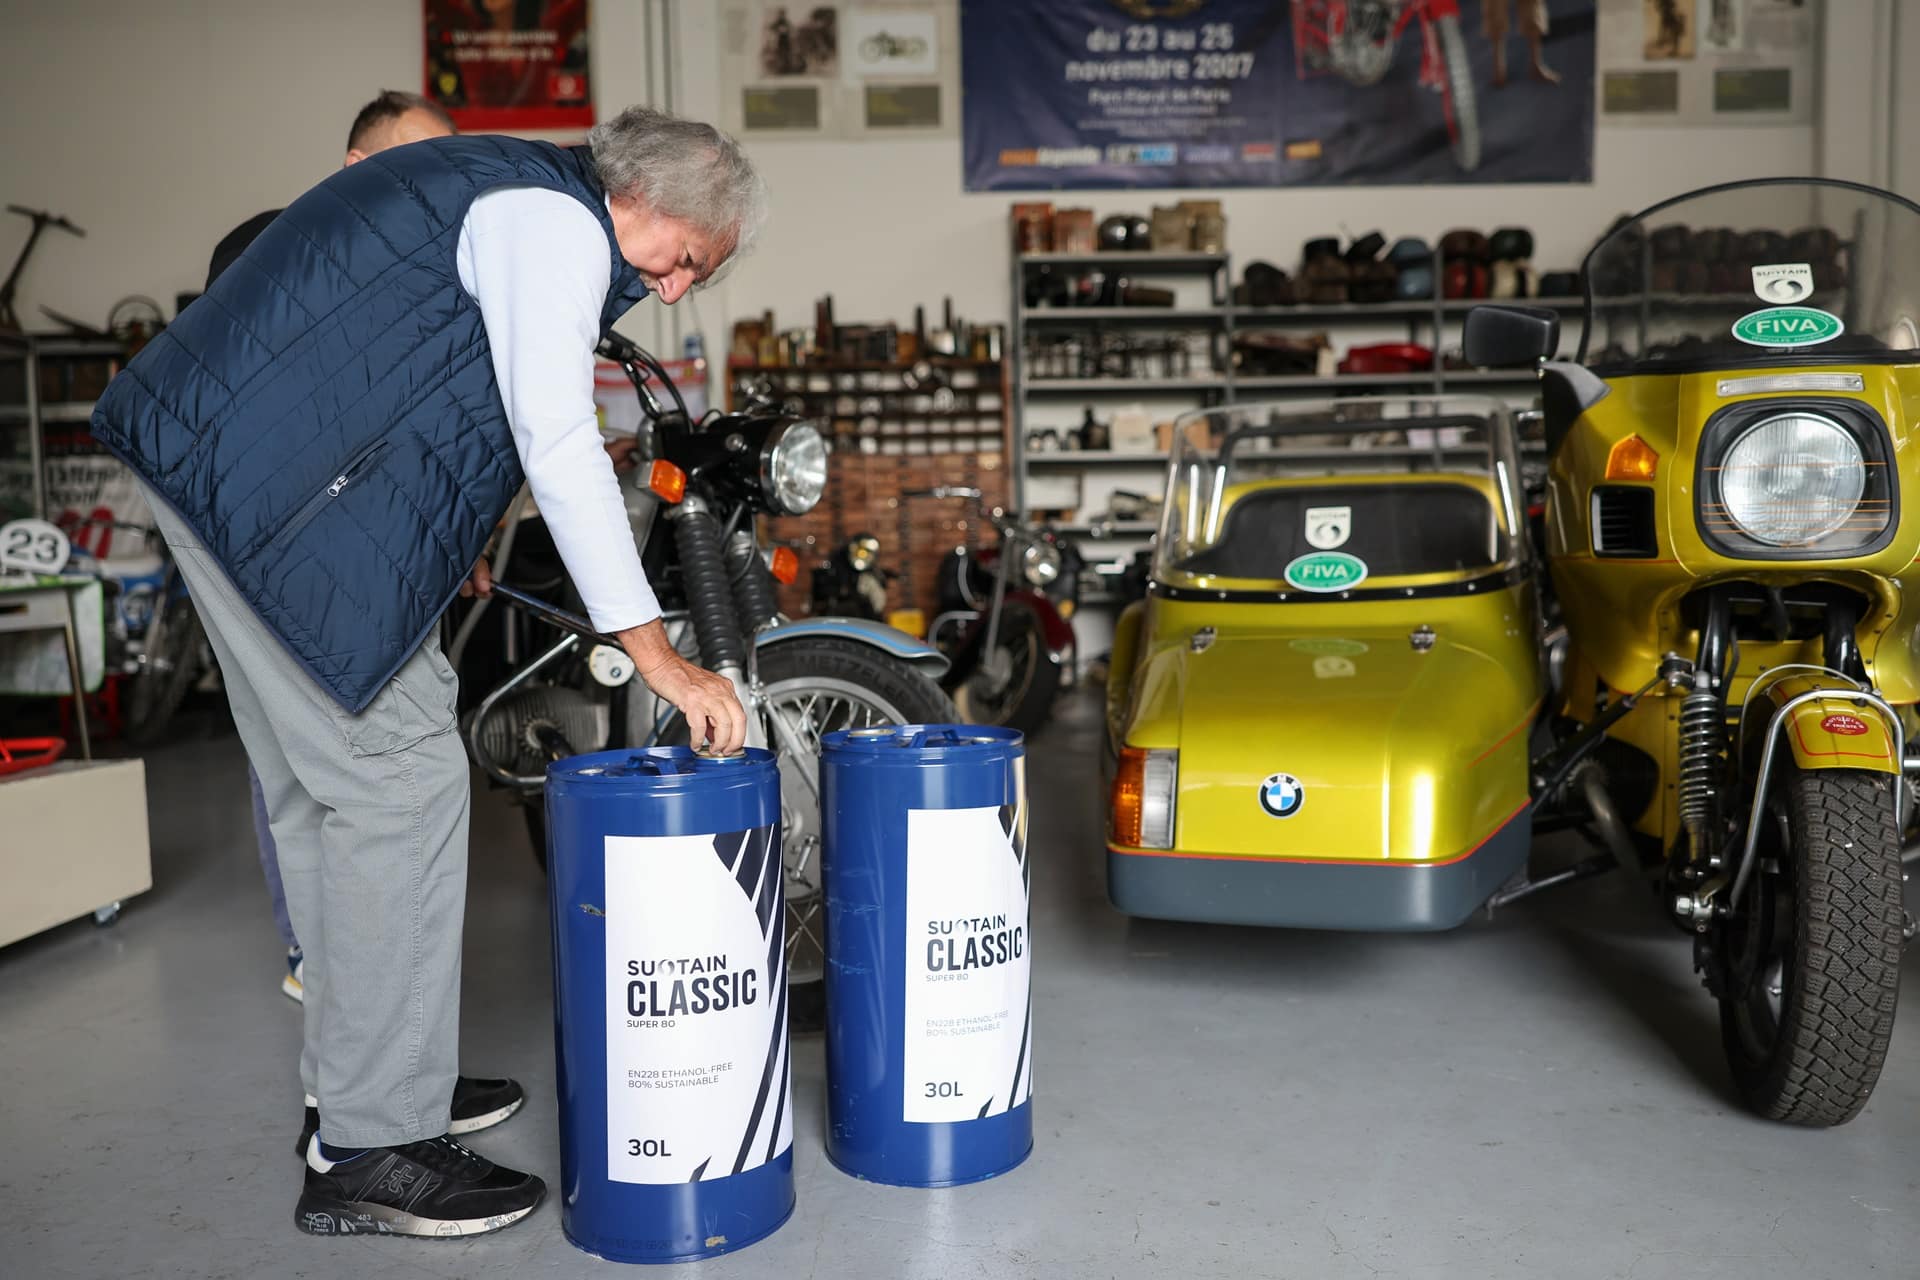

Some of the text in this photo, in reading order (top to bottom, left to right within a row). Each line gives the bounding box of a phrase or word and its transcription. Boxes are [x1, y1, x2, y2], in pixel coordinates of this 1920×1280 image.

[1087, 23, 1233, 52] du 23 au 25
[1065, 52, 1254, 81] novembre 2007
[1757, 318, 1819, 334] FIVA
[6, 527, 59, 564] 23
[1302, 563, 1349, 578] FIVA
[926, 926, 1023, 972] CLASSIC
[926, 973, 969, 983] SUPER 80
[627, 968, 757, 1017] CLASSIC
[627, 1019, 676, 1029] SUPER 80
[628, 1062, 733, 1079] EN228 ETHANOL-FREE
[628, 1075, 720, 1089] 80% SUSTAINABLE
[925, 1081, 963, 1098] 30L
[628, 1138, 672, 1157] 30L
